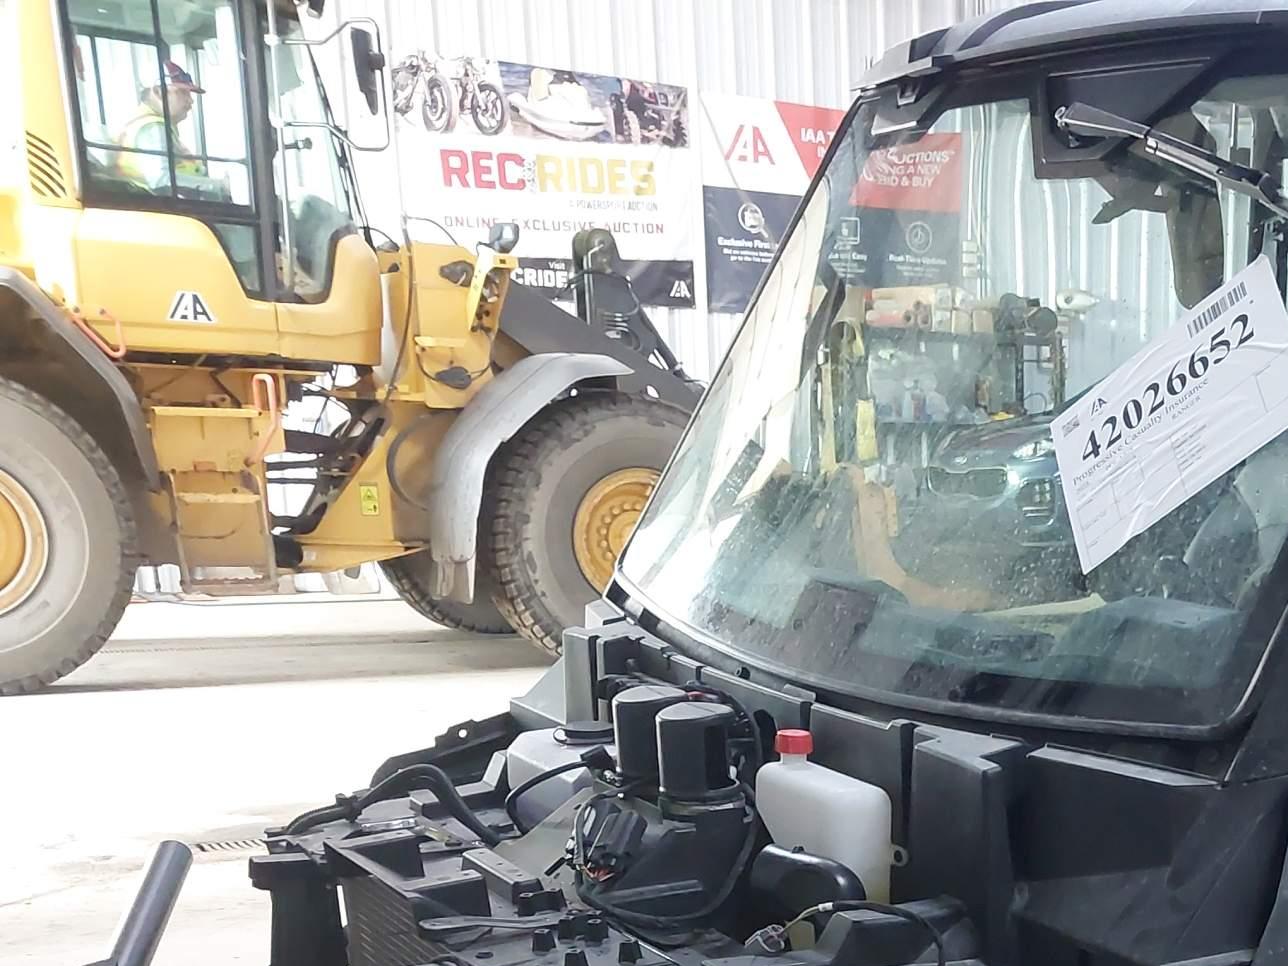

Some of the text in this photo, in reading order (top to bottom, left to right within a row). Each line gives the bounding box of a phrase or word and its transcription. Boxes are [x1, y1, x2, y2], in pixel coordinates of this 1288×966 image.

[800, 127, 826, 144] IAA
[440, 149, 658, 196] REC RIDES
[911, 176, 935, 188] BUY
[548, 261, 567, 270] Visit
[1082, 313, 1255, 461] 42026652
[1072, 445, 1124, 487] Progressive
[1124, 414, 1163, 447] Casualty
[1164, 378, 1209, 414] Insurance
